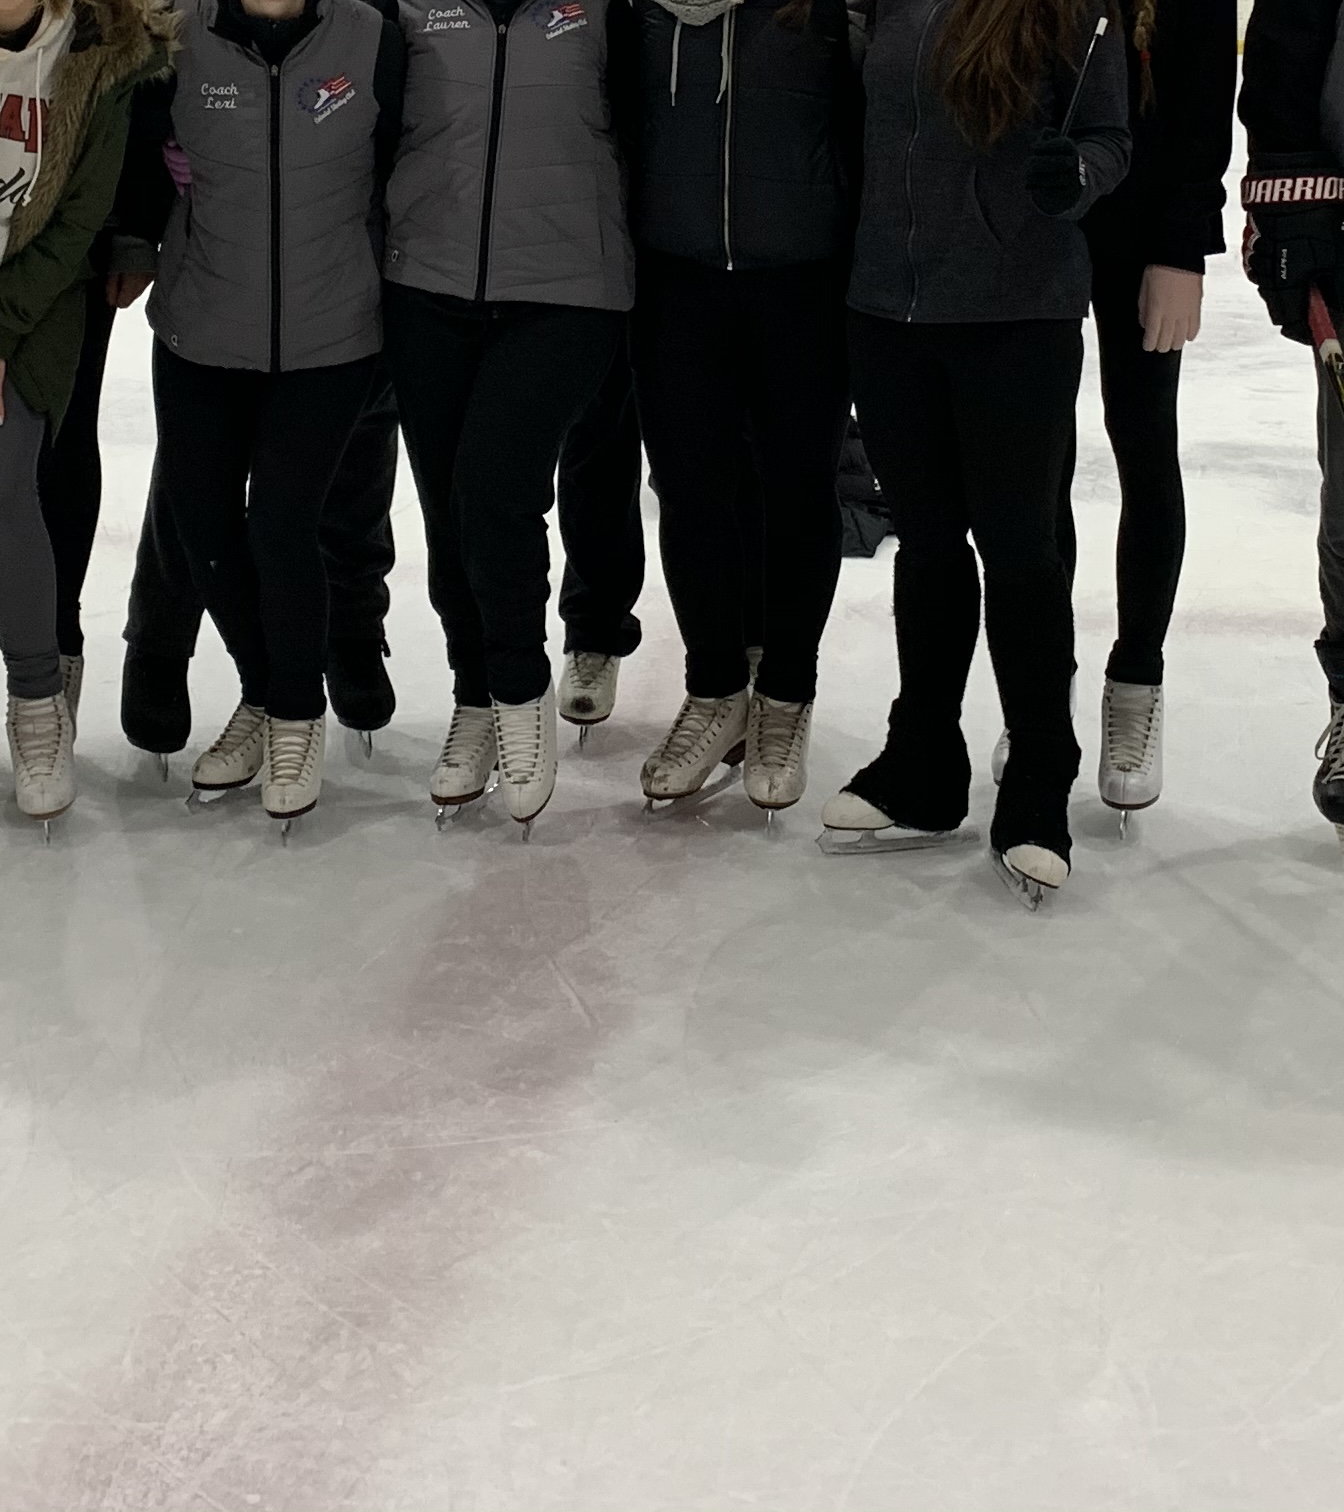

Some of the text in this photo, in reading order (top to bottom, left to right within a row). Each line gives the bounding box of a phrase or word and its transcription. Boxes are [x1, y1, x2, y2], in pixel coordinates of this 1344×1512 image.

[427, 6, 466, 20] Coach
[423, 20, 471, 32] Lauren
[201, 83, 240, 96] Coach
